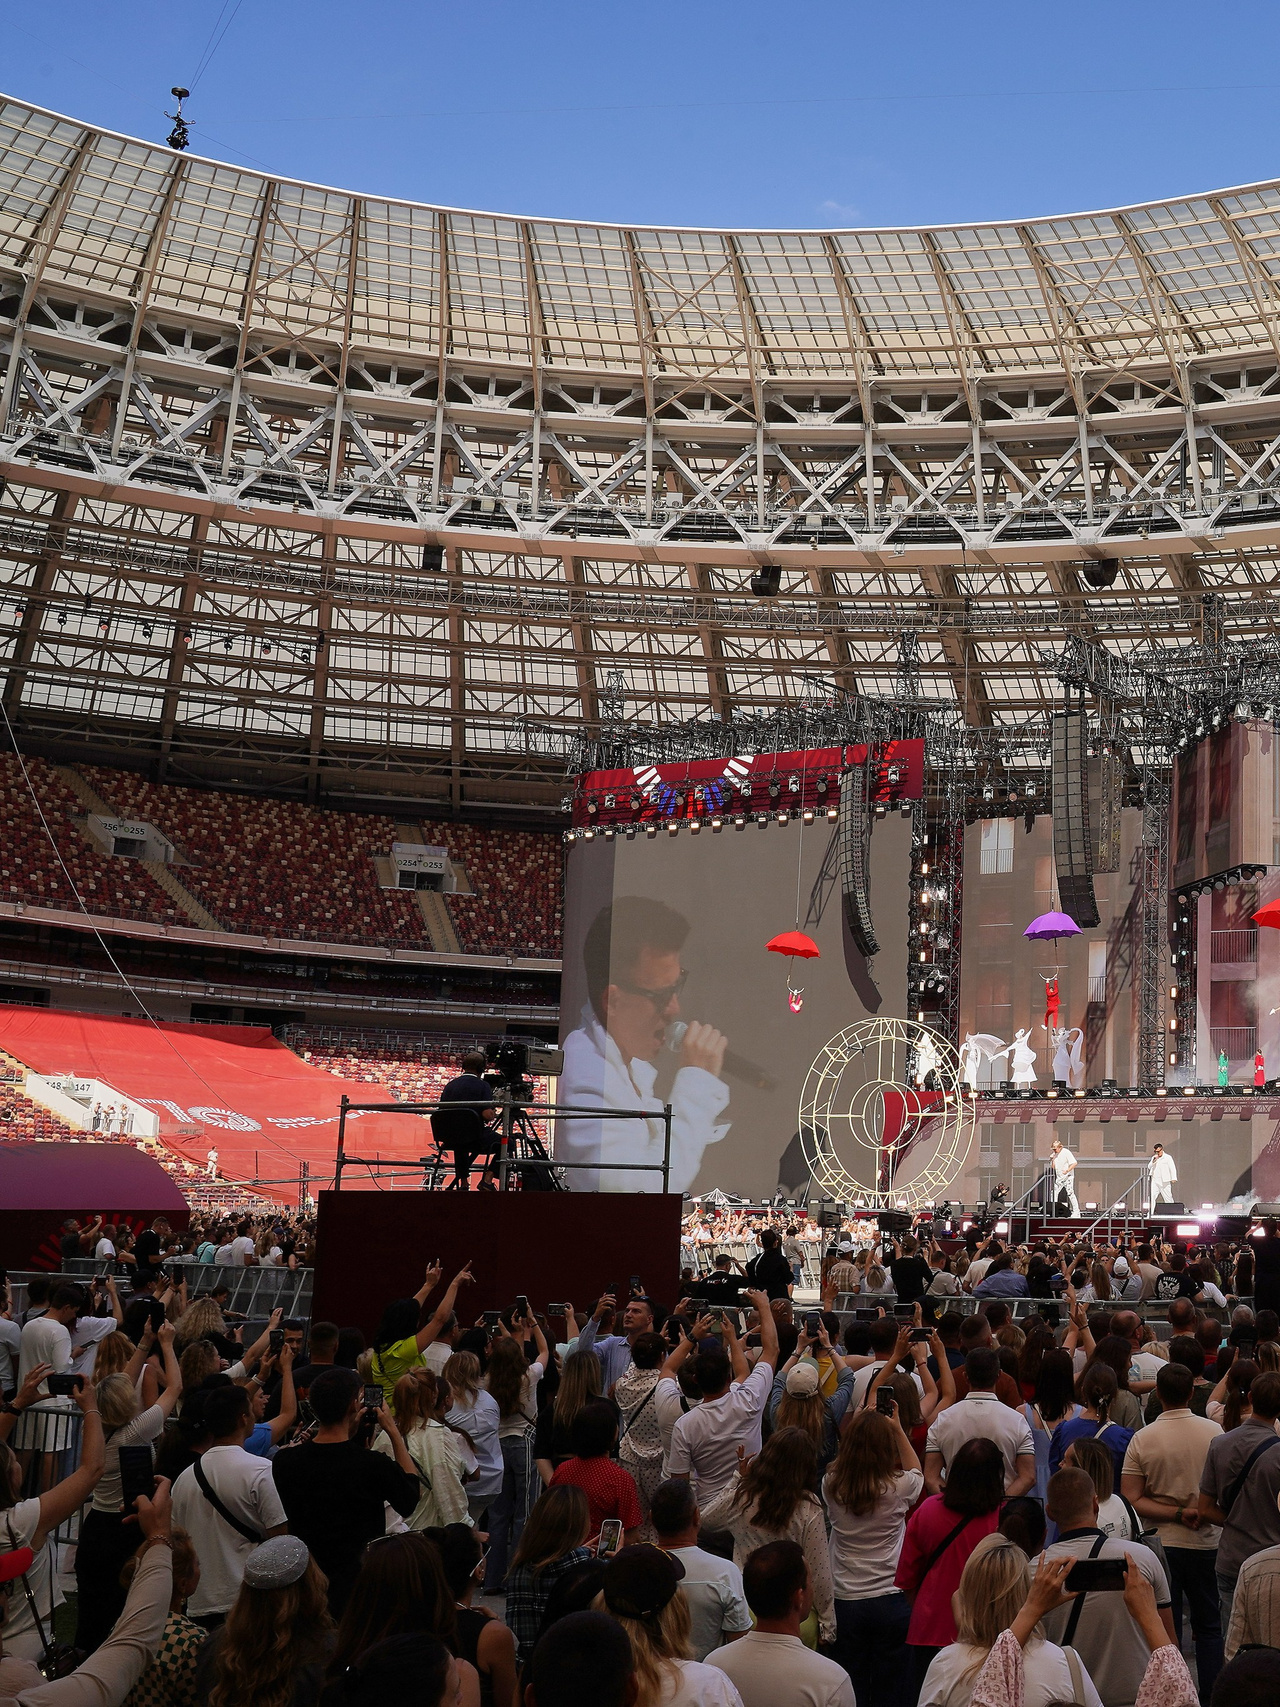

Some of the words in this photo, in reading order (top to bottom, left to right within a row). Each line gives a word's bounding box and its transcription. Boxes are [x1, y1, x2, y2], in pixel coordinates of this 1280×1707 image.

[129, 827, 145, 835] 255
[402, 859, 417, 867] 254
[428, 861, 443, 869] 253
[46, 1082, 62, 1090] 48
[74, 1083, 91, 1092] 147
[266, 1116, 316, 1124] ДЕНЬ
